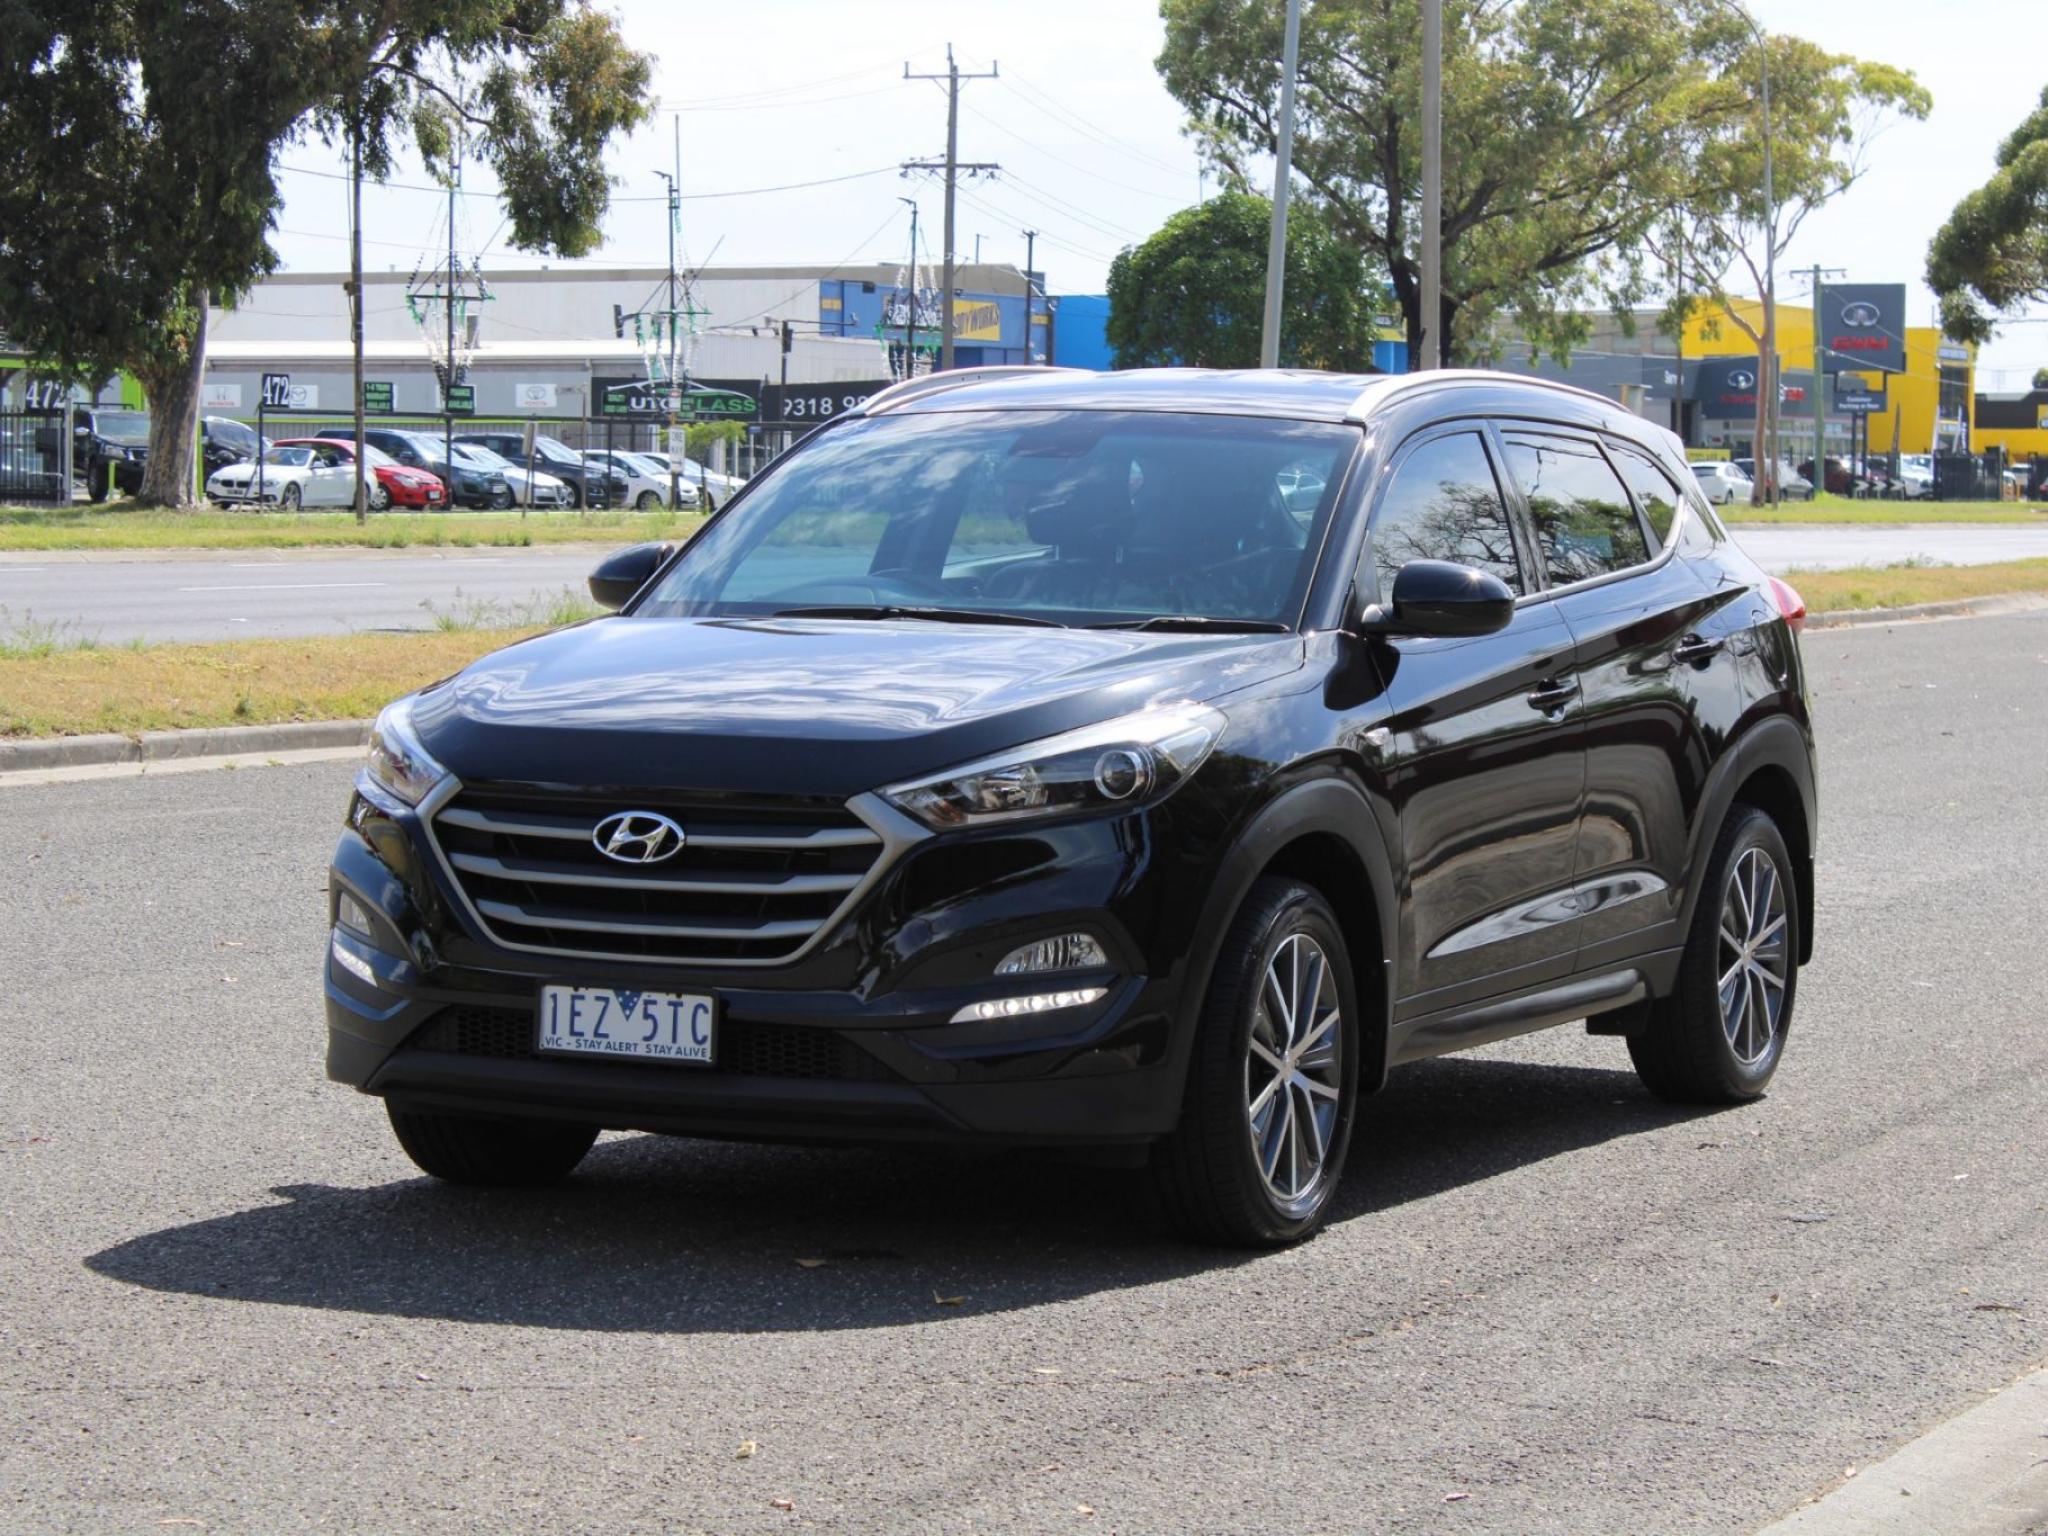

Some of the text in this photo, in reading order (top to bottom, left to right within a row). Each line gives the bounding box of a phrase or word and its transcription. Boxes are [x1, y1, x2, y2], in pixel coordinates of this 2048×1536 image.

[263, 376, 289, 405] 472
[550, 992, 709, 1045] 1EZ 5TC
[544, 1036, 562, 1048] VIC
[575, 1038, 603, 1051] STAY
[604, 1040, 639, 1053] ALERT
[645, 1043, 674, 1055] STAY
[675, 1045, 708, 1058] ALIVE
